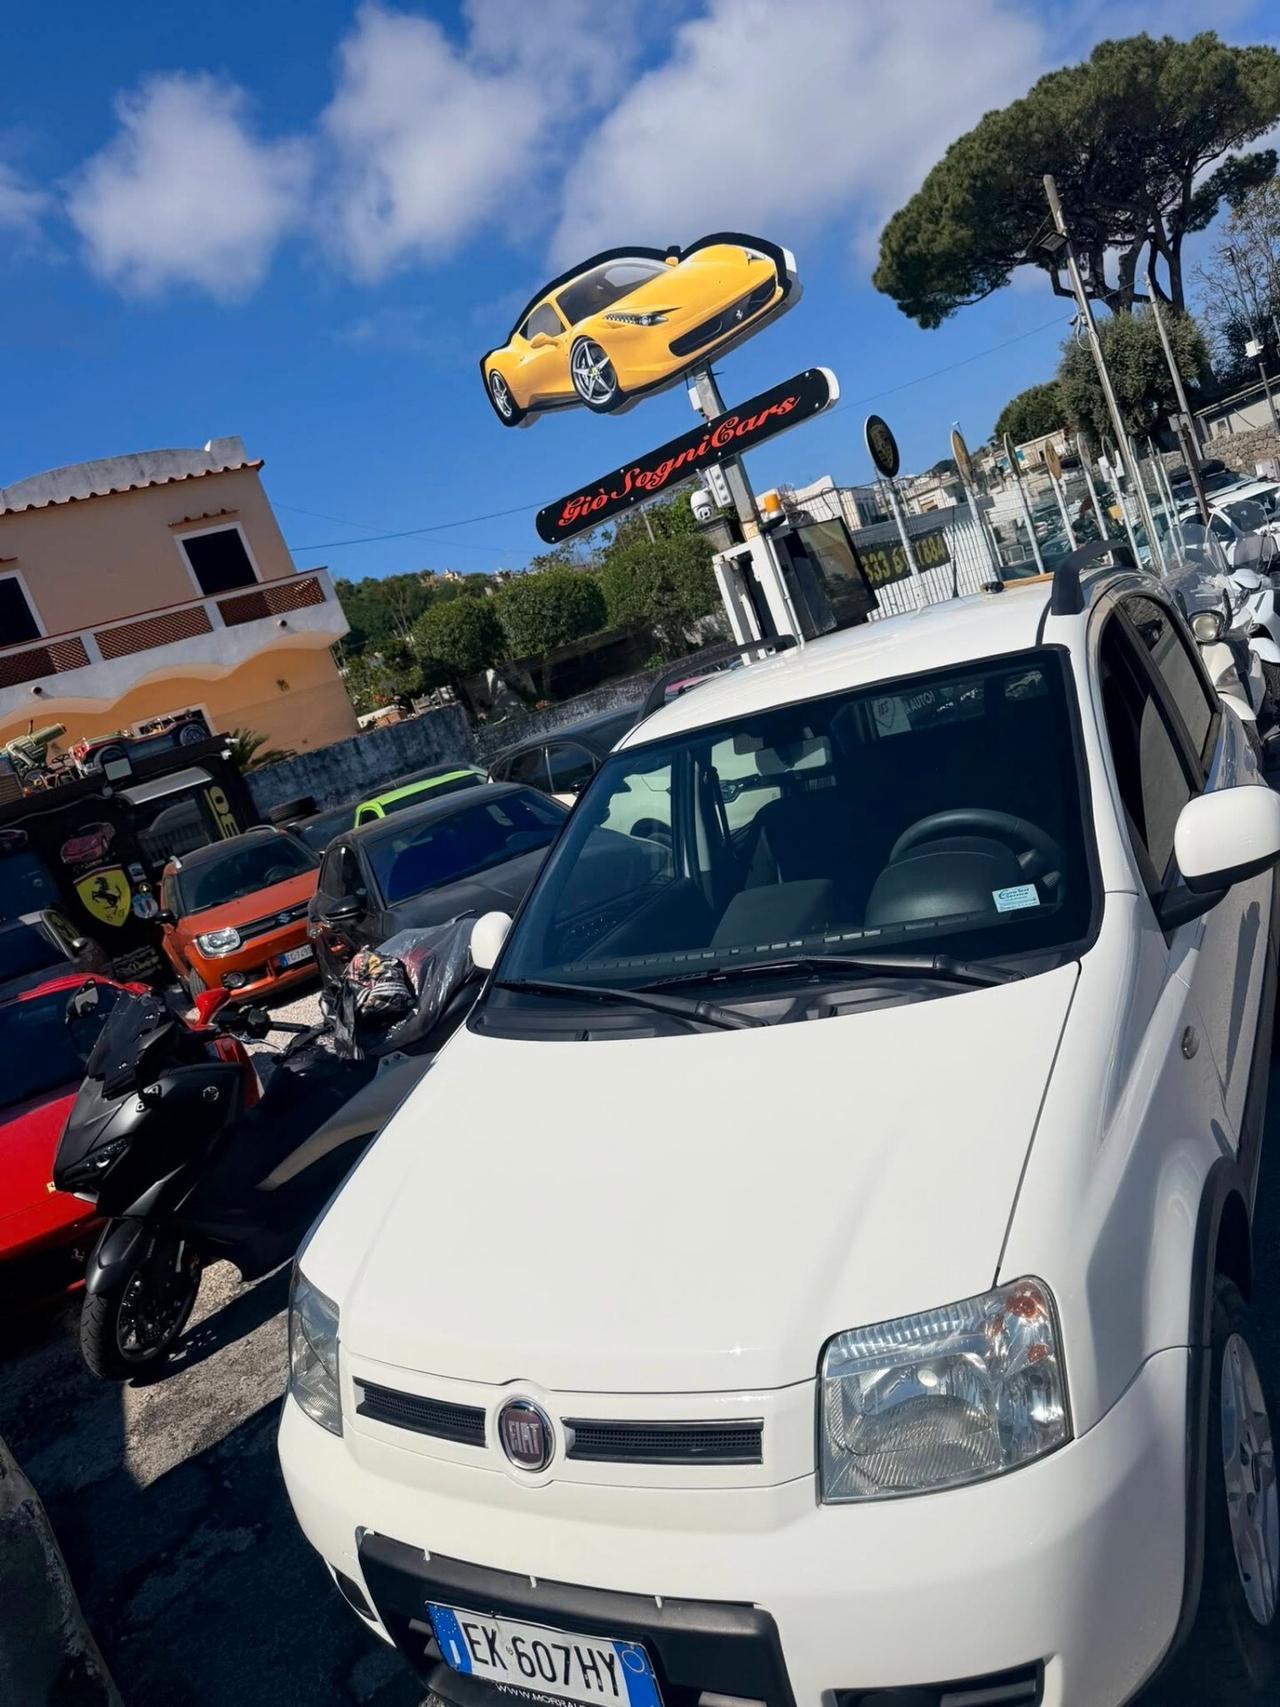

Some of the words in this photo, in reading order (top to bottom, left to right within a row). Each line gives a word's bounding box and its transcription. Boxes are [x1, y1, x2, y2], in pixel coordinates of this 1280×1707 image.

[558, 488, 609, 527] Giò
[711, 394, 800, 448] Cars
[508, 1421, 540, 1454] FIAT
